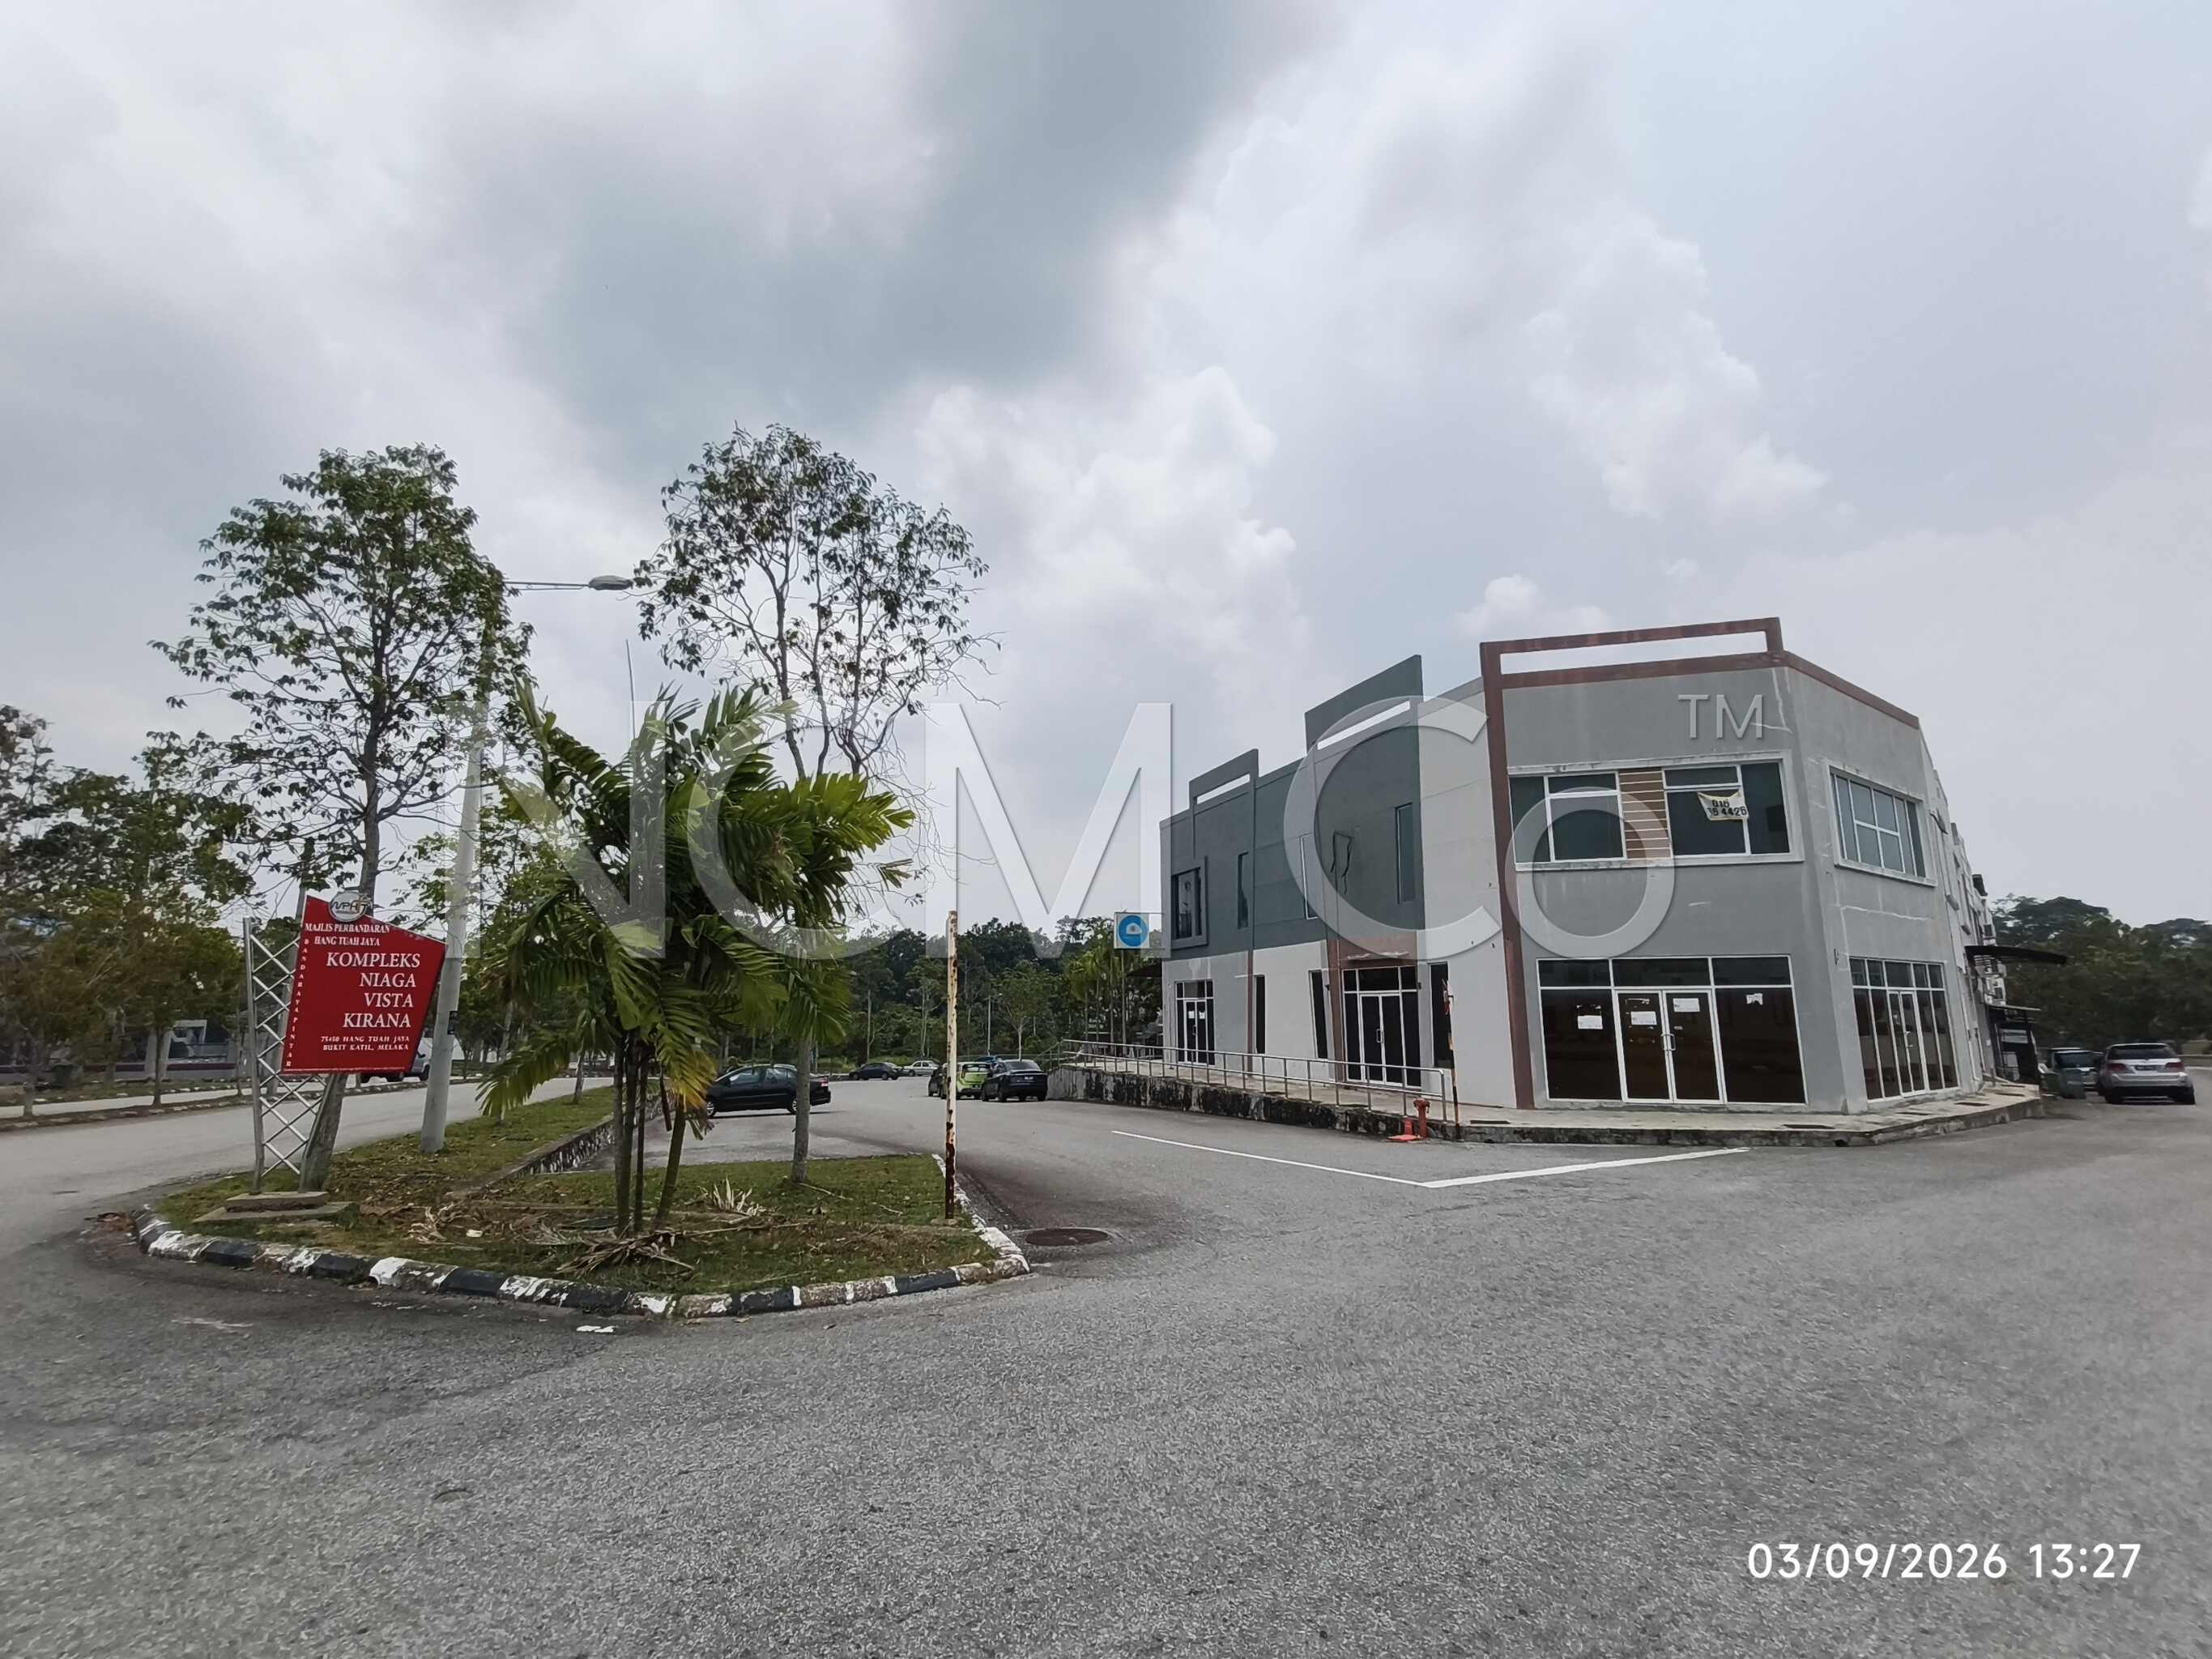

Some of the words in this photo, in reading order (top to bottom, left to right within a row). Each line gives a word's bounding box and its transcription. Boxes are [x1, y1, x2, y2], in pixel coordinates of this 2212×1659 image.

[305, 923, 333, 932] MAJLIS
[335, 923, 390, 933] PERBANDARAN
[314, 936, 337, 945] HANG
[339, 936, 359, 945] TUAH
[360, 937, 381, 946] JAYA
[326, 952, 421, 968] KOMPLEKS
[295, 938, 309, 1013] BANDARAYA
[359, 972, 416, 987] NIAGA
[364, 992, 414, 1008] VISTA
[343, 1013, 411, 1028] KIRANA
[286, 1017, 298, 1067] PINTAR
